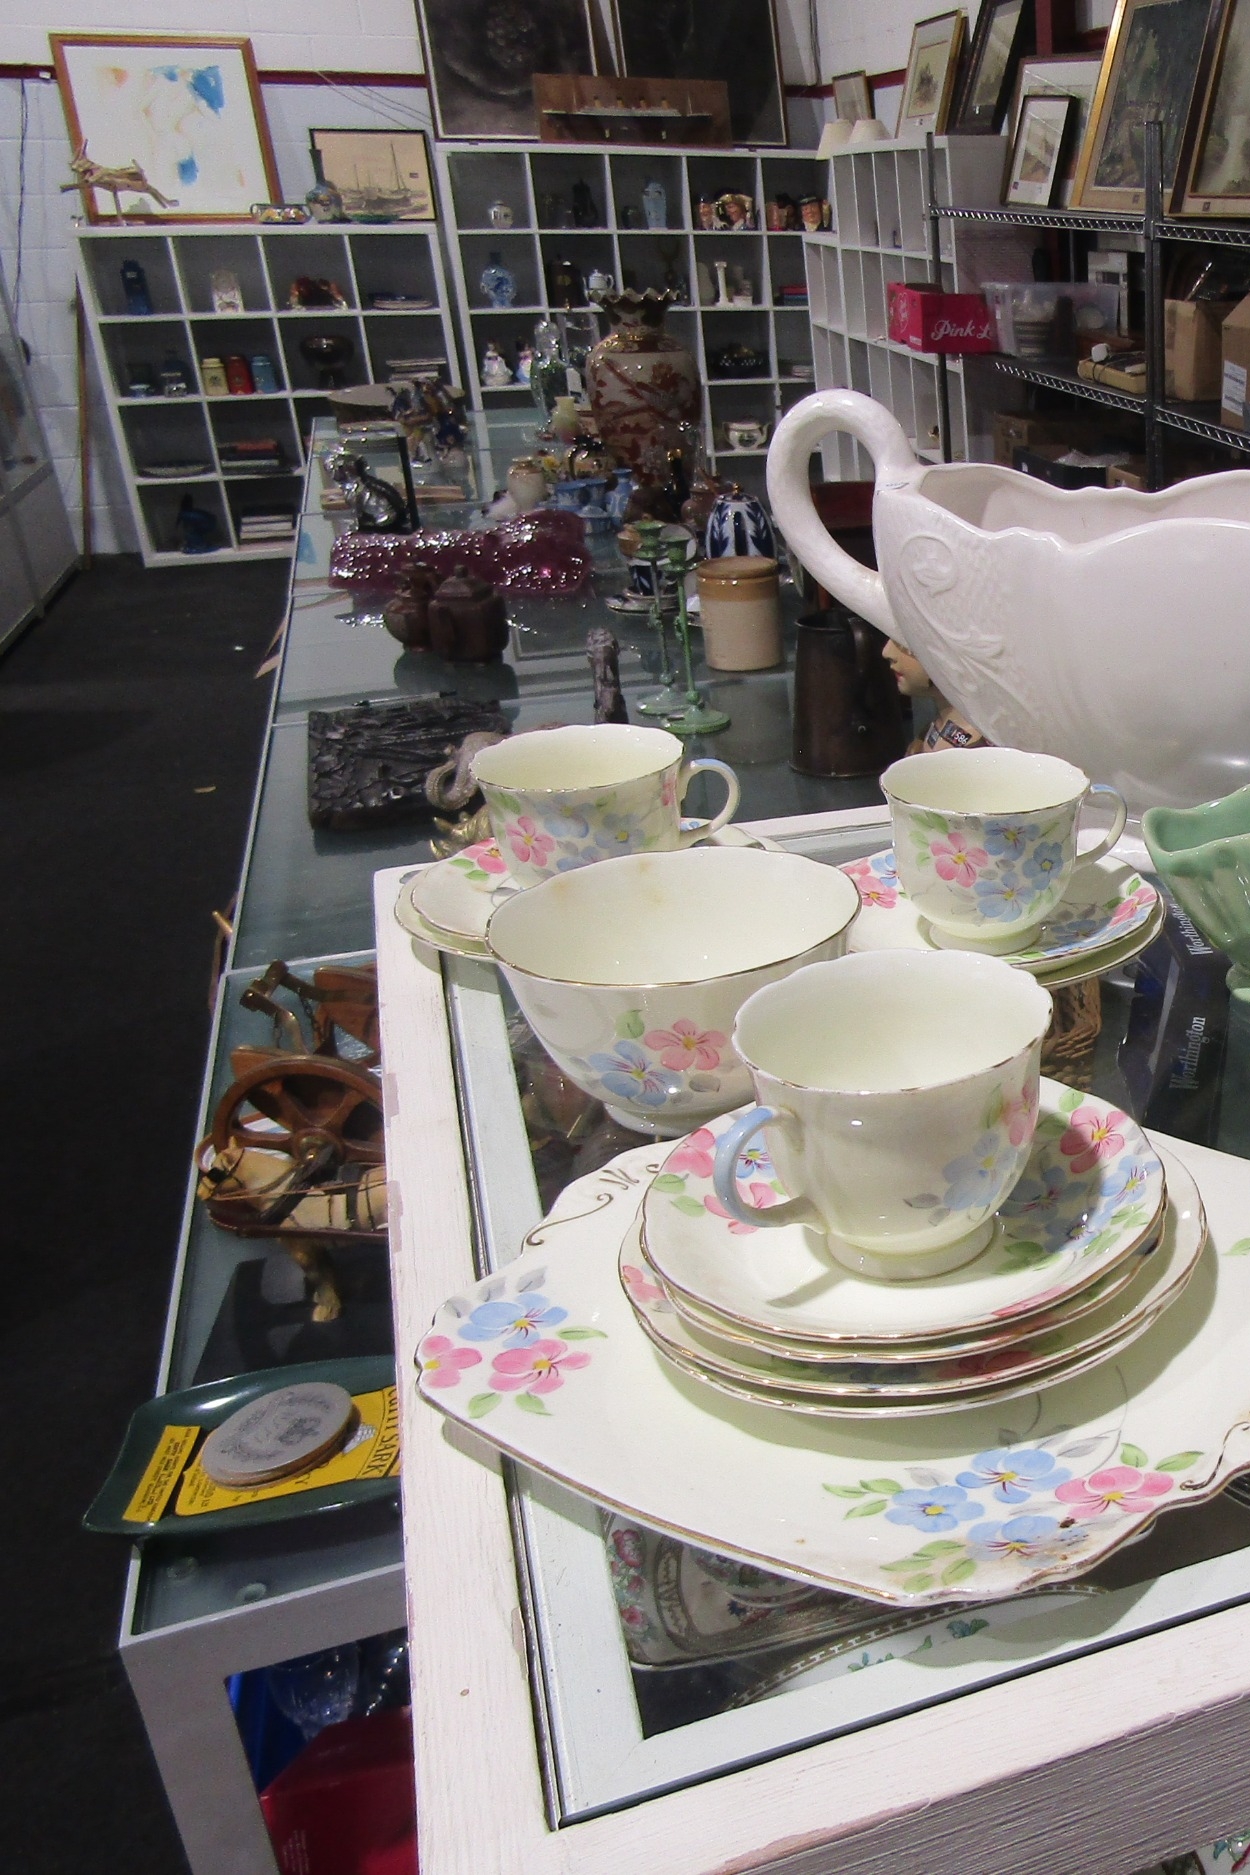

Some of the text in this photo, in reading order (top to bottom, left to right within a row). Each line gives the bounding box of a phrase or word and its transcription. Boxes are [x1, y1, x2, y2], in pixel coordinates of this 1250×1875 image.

[931, 319, 975, 341] Pink
[1170, 903, 1214, 955] Worthington
[1169, 1016, 1210, 1089] Worthington
[361, 1433, 399, 1475] SARK
